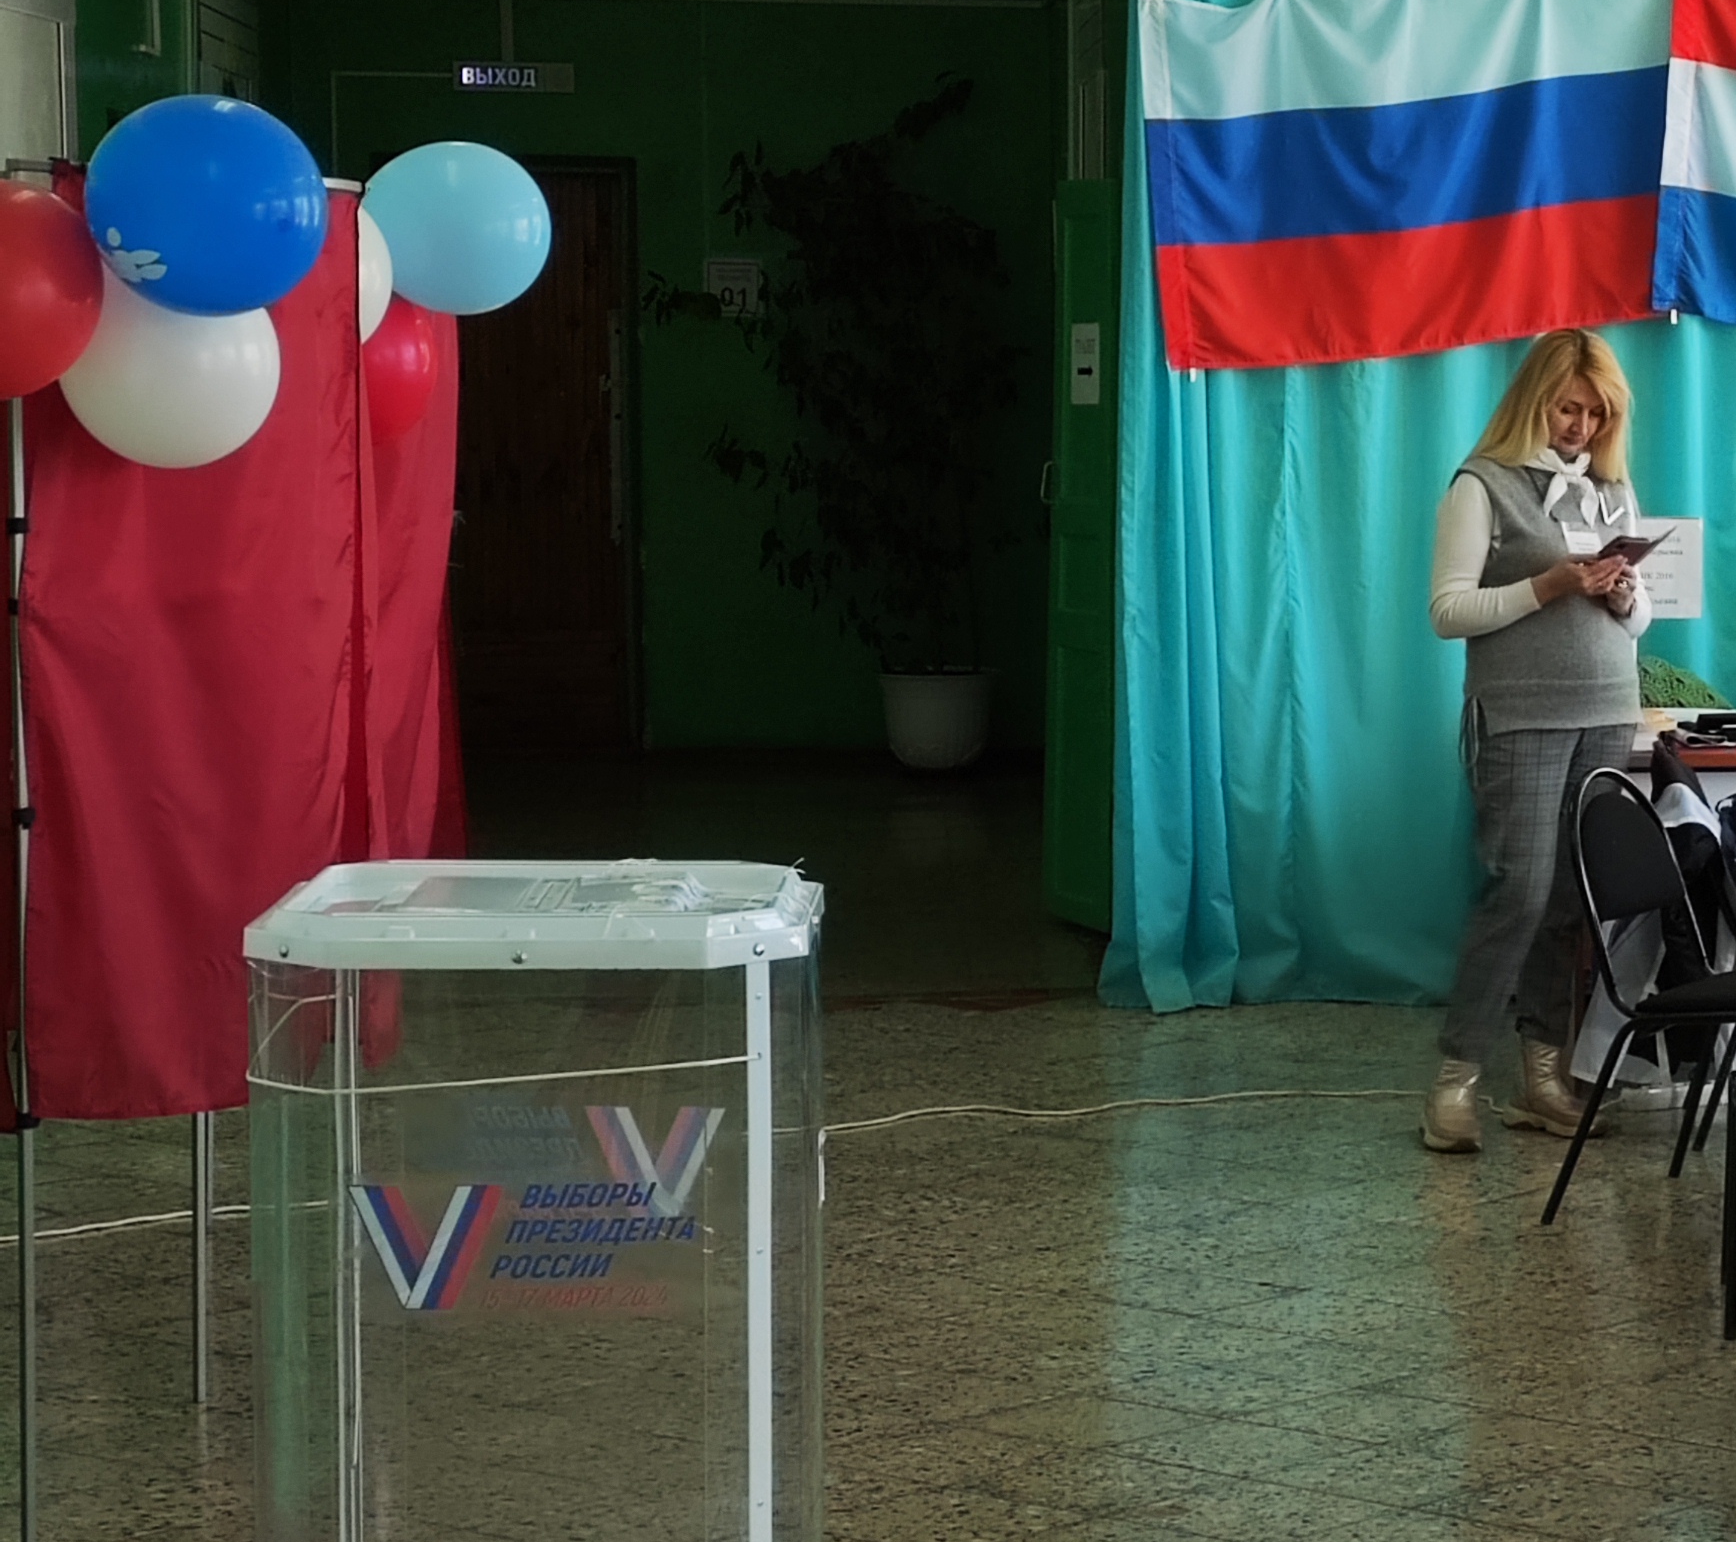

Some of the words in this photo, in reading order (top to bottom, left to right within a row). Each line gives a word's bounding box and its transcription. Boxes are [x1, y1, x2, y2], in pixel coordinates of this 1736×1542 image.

[462, 67, 536, 87] ВЫХОД
[721, 287, 746, 310] 01
[520, 1182, 657, 1208] ВЫБОРЫ
[505, 1216, 696, 1245] ПРЕЗИДЕНТА
[490, 1254, 614, 1279] РОССИИ
[542, 1287, 614, 1308] МАРТА
